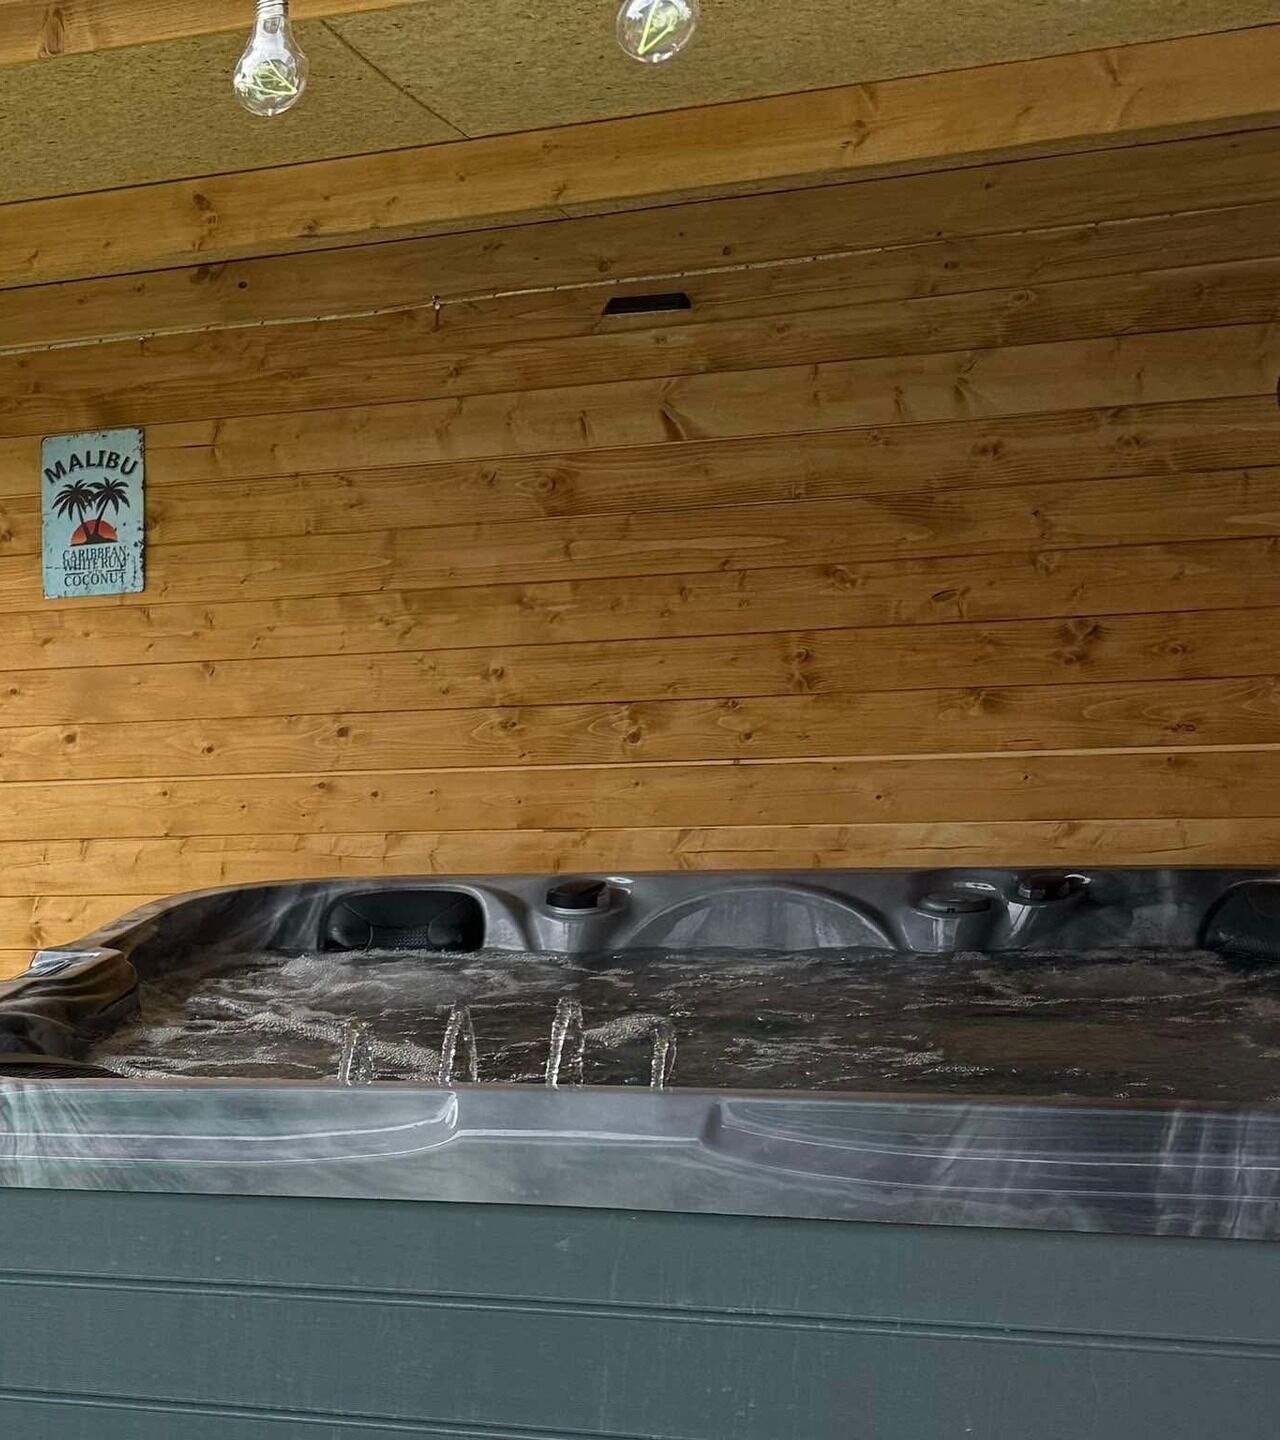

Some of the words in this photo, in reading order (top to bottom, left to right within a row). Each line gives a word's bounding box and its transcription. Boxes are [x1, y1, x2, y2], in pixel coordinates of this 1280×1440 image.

[44, 450, 138, 484] MALIBU
[63, 558, 99, 571] WHITE
[64, 572, 127, 587] COCONUT
